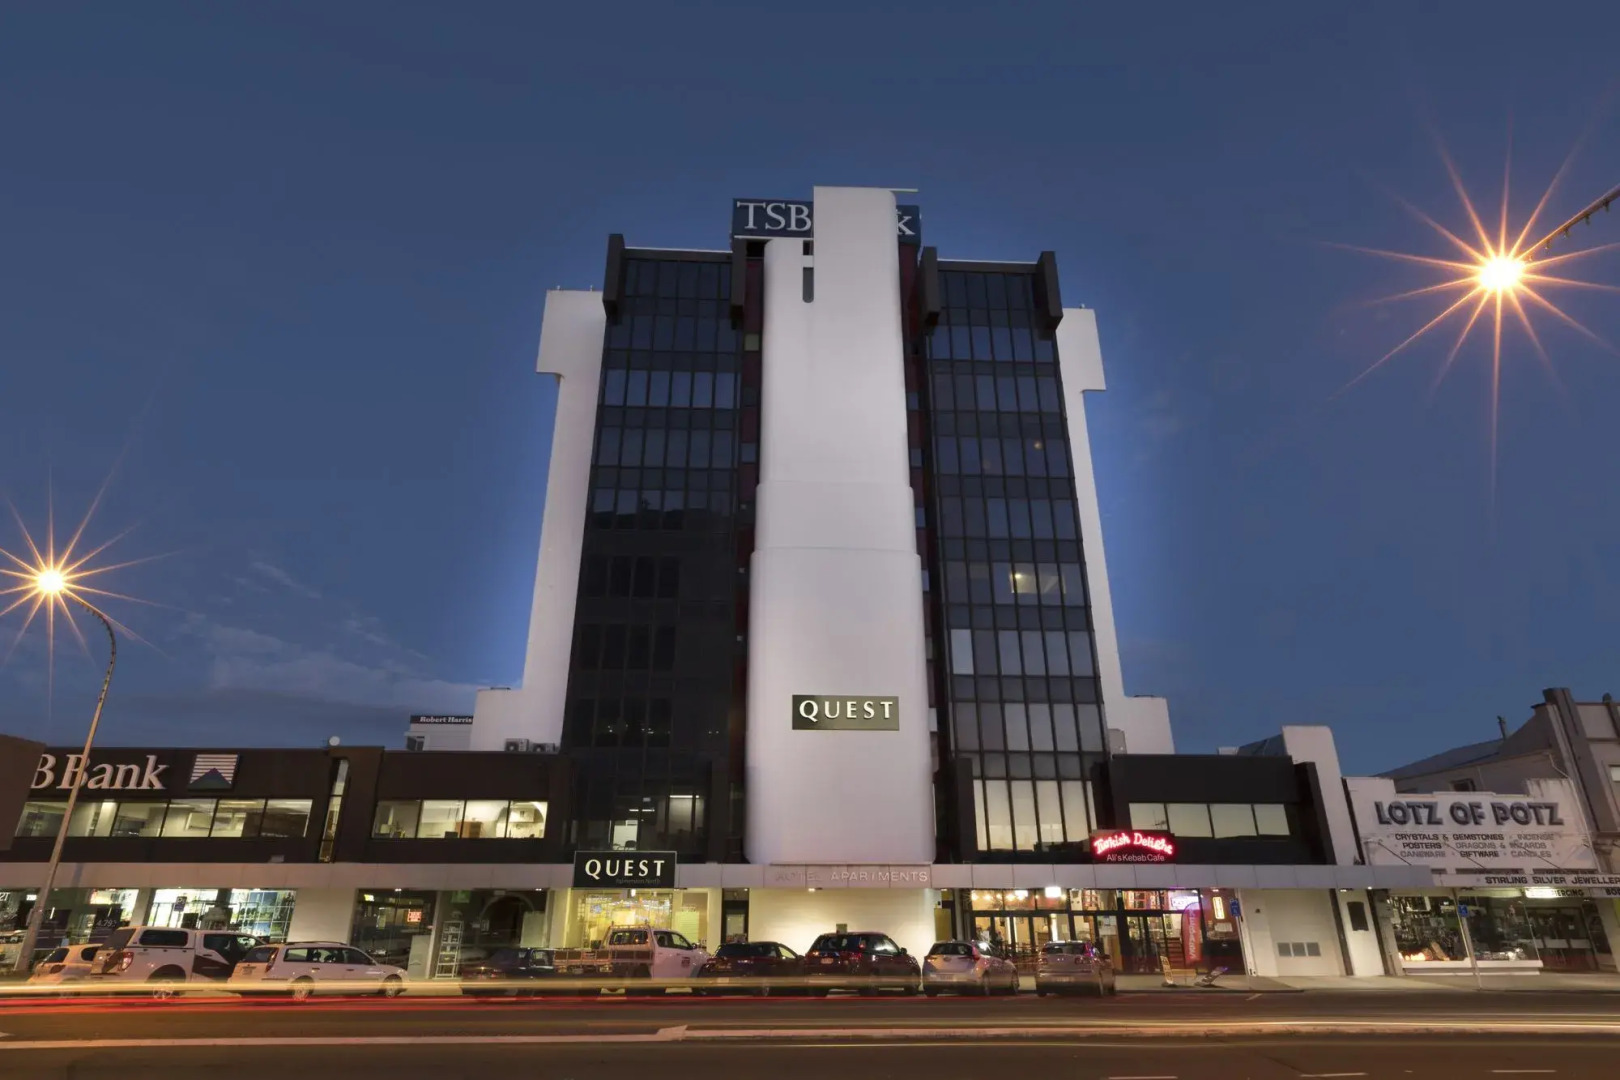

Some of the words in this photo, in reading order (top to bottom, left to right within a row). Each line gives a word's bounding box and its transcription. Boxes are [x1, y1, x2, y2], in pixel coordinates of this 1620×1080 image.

[736, 201, 812, 232] TSB
[799, 699, 893, 723] QUEST
[56, 753, 170, 790] Bank
[1374, 801, 1443, 825] LOTZ
[1450, 801, 1485, 825] OF
[1490, 802, 1565, 826] POTZ
[1093, 833, 1131, 855] Turkish
[1394, 833, 1440, 841] CRYSTALS
[1452, 833, 1505, 841] GEMSTONES
[1123, 854, 1147, 862] Kebab
[1147, 854, 1165, 862] Cafe
[1399, 850, 1447, 858] CANEWARE
[1459, 850, 1500, 858] GIFTWARE
[1510, 850, 1552, 858] CANDLES
[584, 858, 665, 880] QUEST
[830, 871, 928, 882] APARTMENTS
[1485, 876, 1528, 885] STIRLING
[1532, 876, 1567, 885] SILVER
[1551, 889, 1585, 897] IERCING
